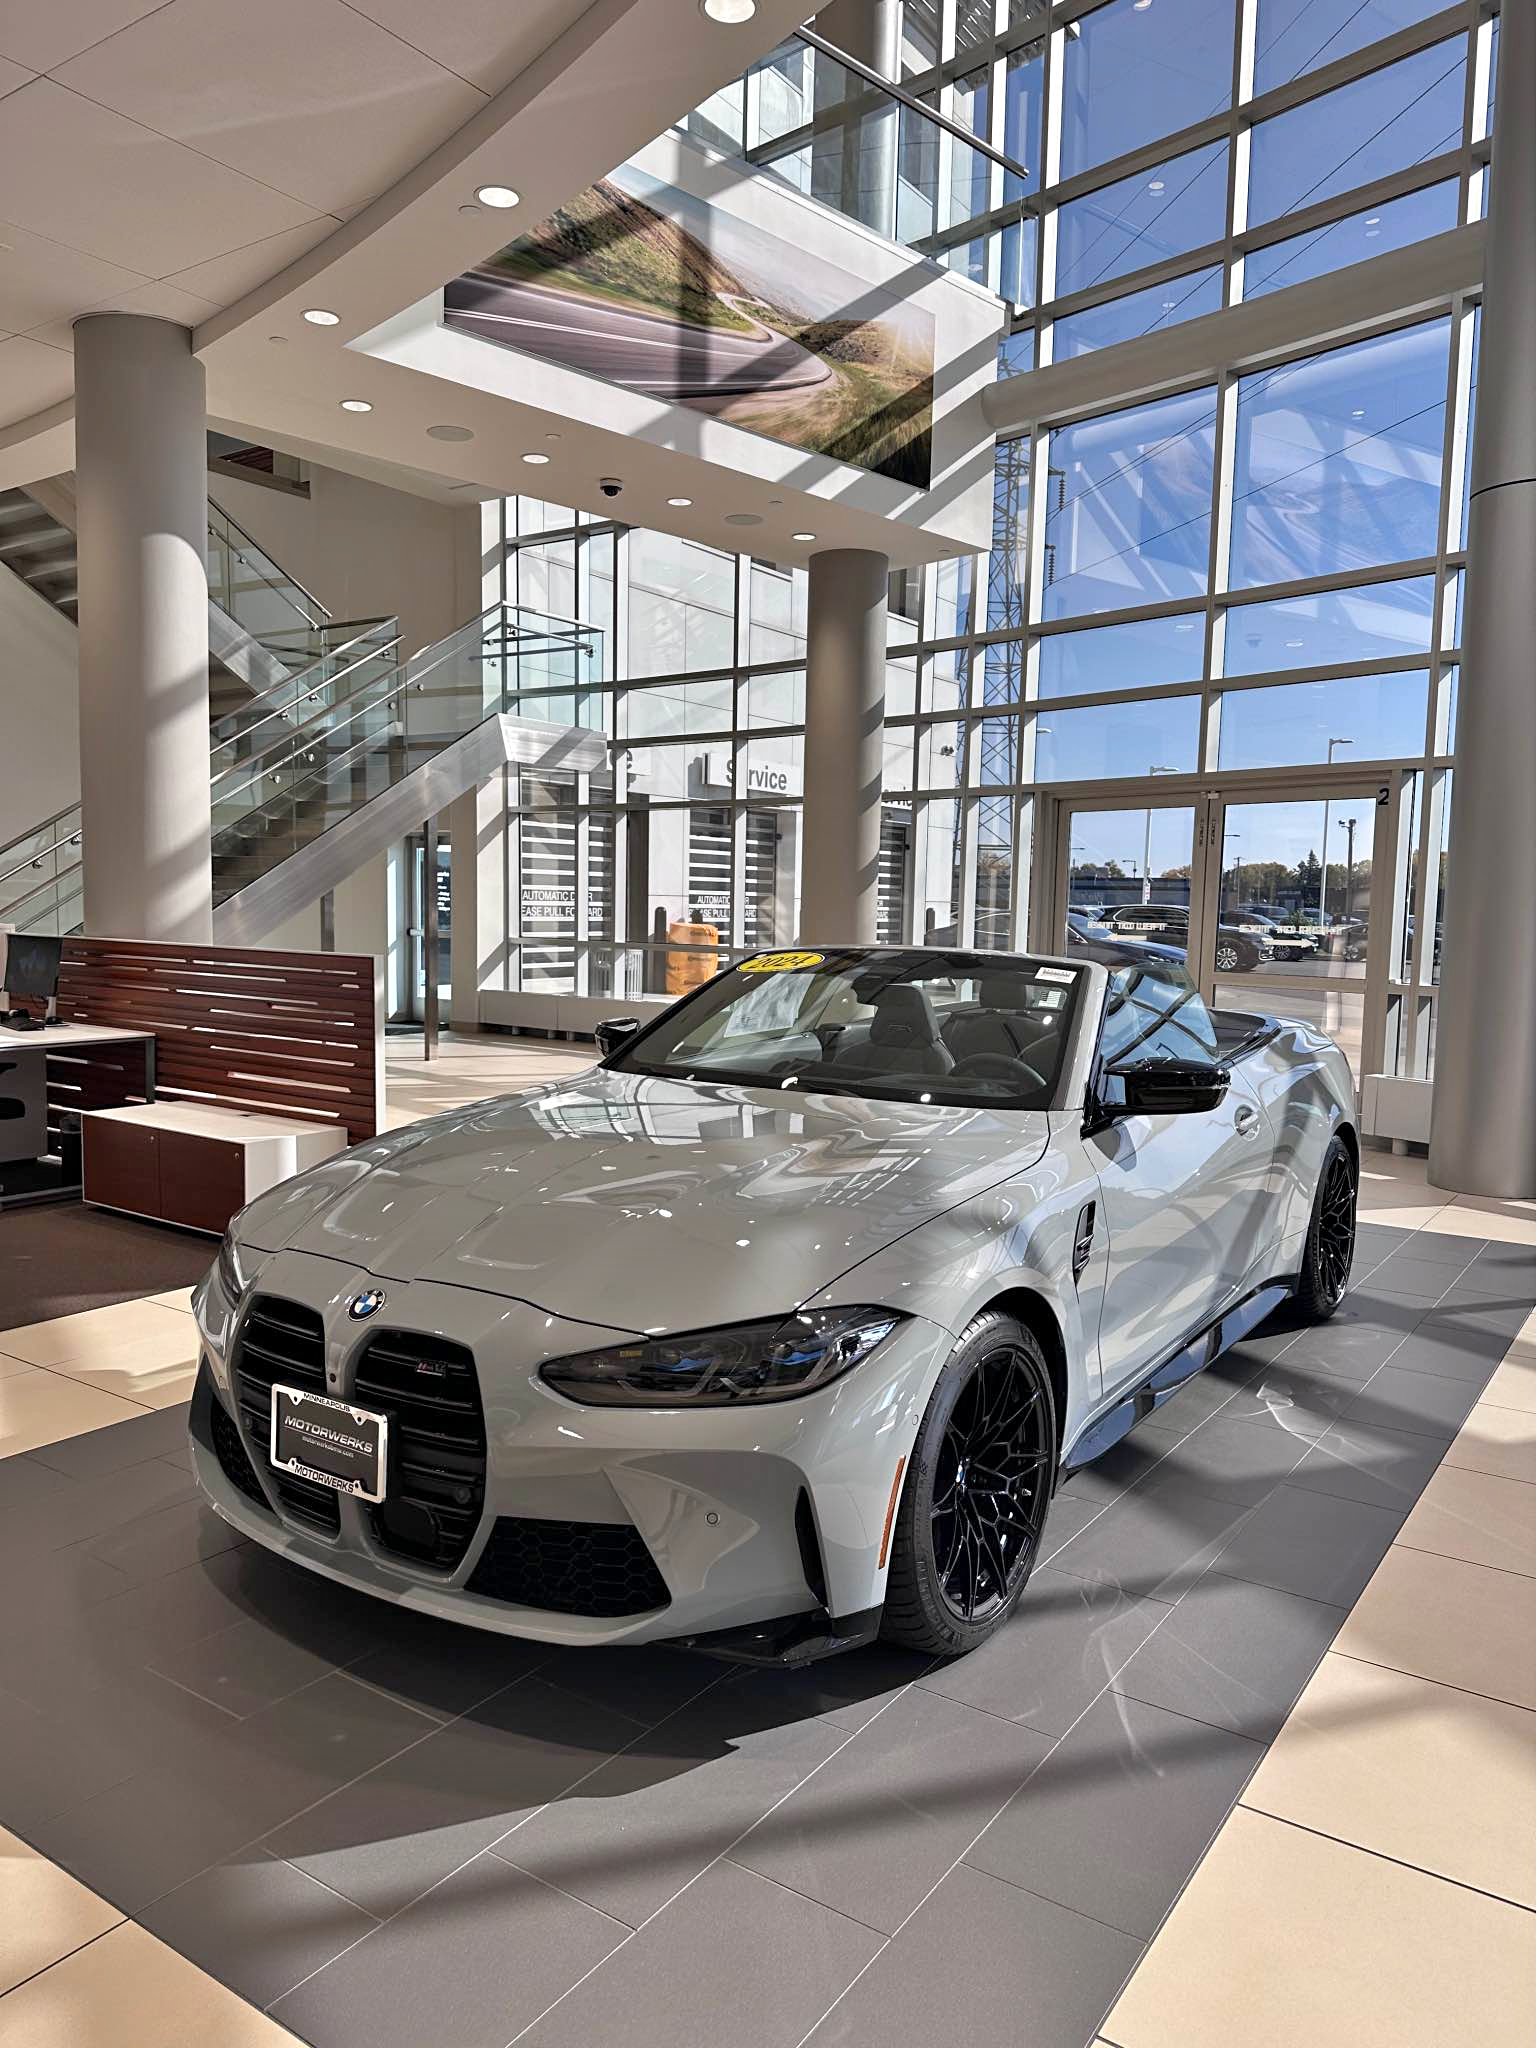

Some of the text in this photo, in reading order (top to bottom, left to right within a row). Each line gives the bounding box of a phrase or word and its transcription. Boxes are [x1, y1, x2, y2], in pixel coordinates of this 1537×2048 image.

[726, 760, 787, 790] Srvice
[1377, 788, 1389, 805] 2
[522, 890, 569, 901] AUTOMATIC
[544, 907, 563, 917] PULL
[746, 955, 814, 969] 2024
[284, 1416, 373, 1453] MOTORWERKS
[294, 1464, 354, 1494] MOTORWERKS
